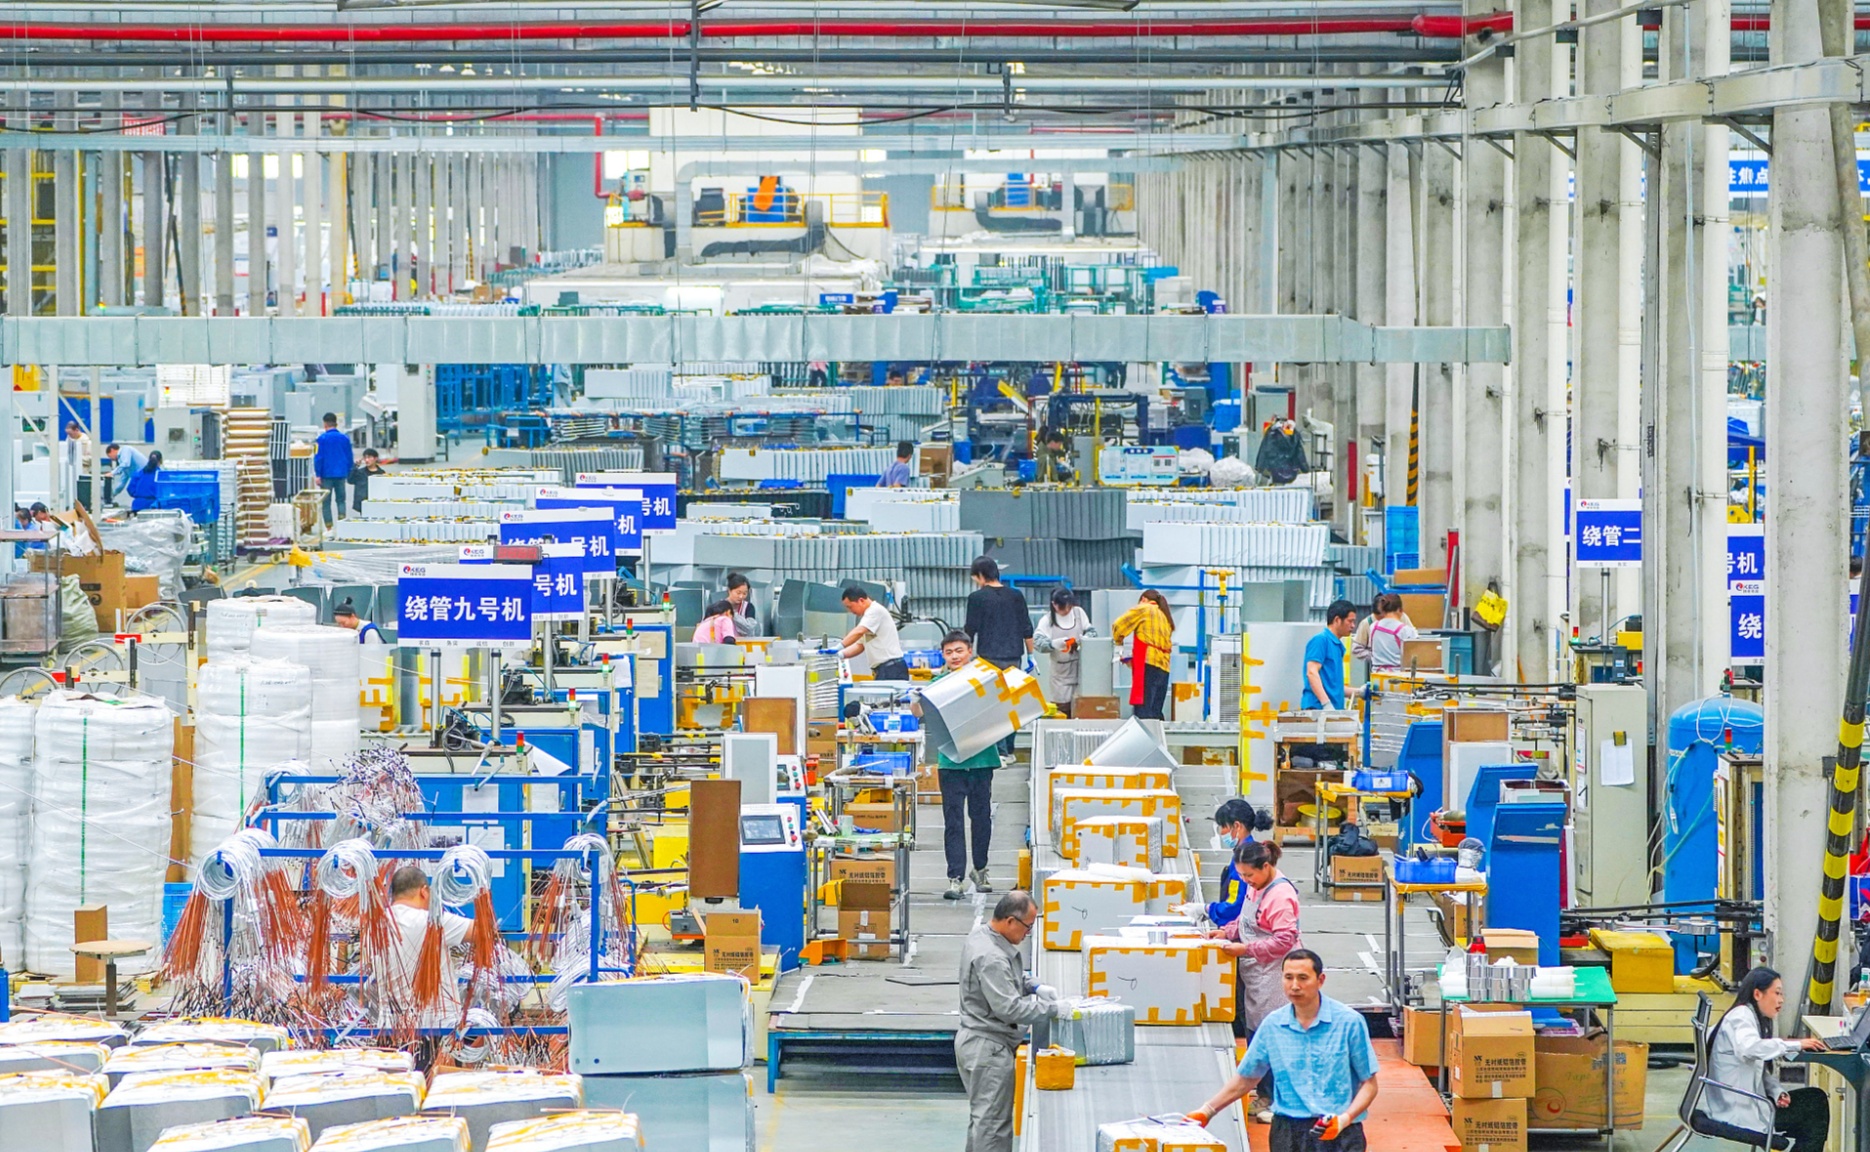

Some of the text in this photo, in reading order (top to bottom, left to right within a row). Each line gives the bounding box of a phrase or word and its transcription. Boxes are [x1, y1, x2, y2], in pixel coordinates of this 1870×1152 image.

[613, 514, 637, 535] 机
[1582, 525, 1641, 547] 绕管二
[533, 573, 578, 597] 号机
[404, 595, 526, 622] 绕管九号机
[1738, 613, 1763, 639] 绕
